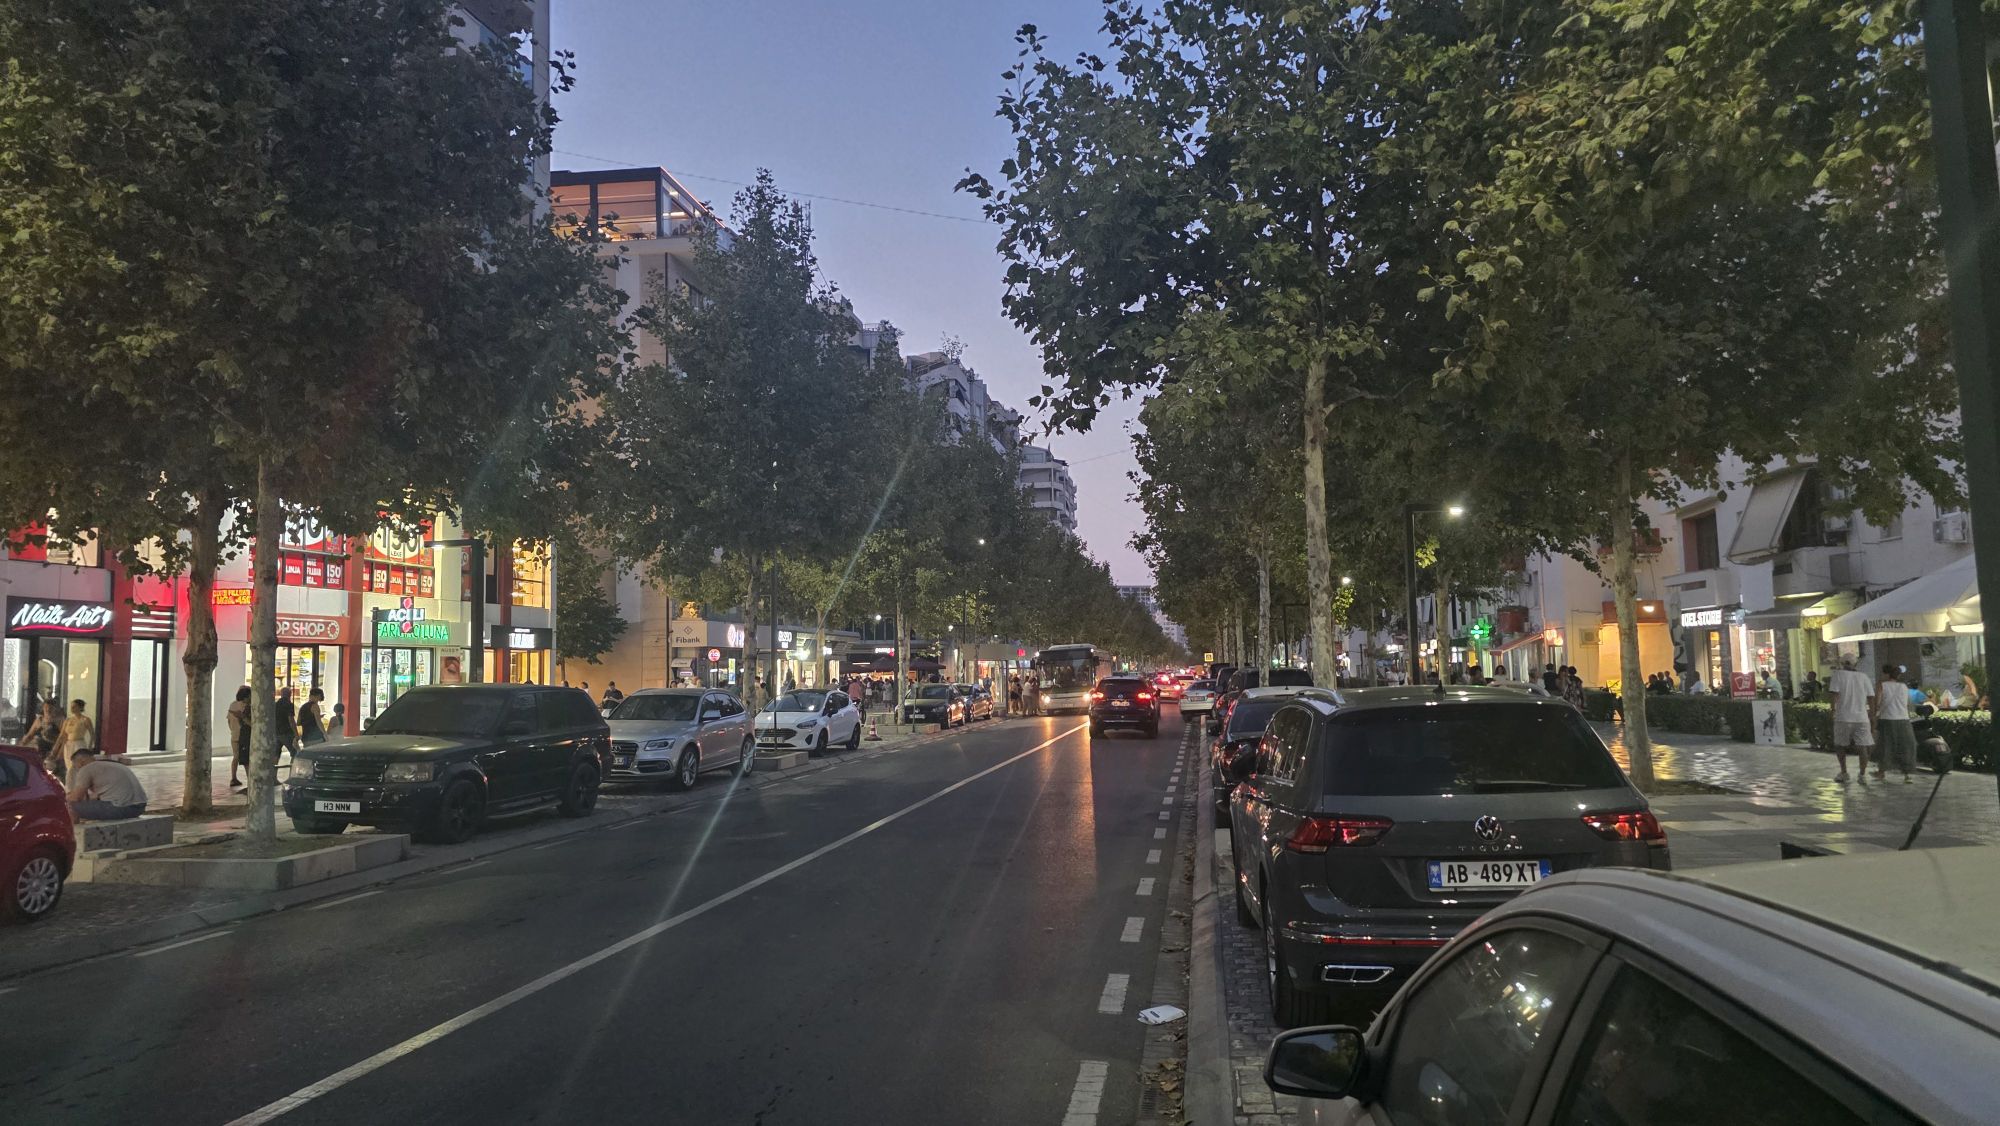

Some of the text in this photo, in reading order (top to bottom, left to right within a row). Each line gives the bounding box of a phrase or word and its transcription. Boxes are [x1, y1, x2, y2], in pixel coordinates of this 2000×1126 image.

[326, 564, 342, 578] 150
[11, 603, 66, 626] Nails
[1697, 610, 1722, 626] STORE
[292, 621, 325, 636] SHOP
[424, 624, 449, 640] LUNA
[323, 803, 351, 811] H3 NNW
